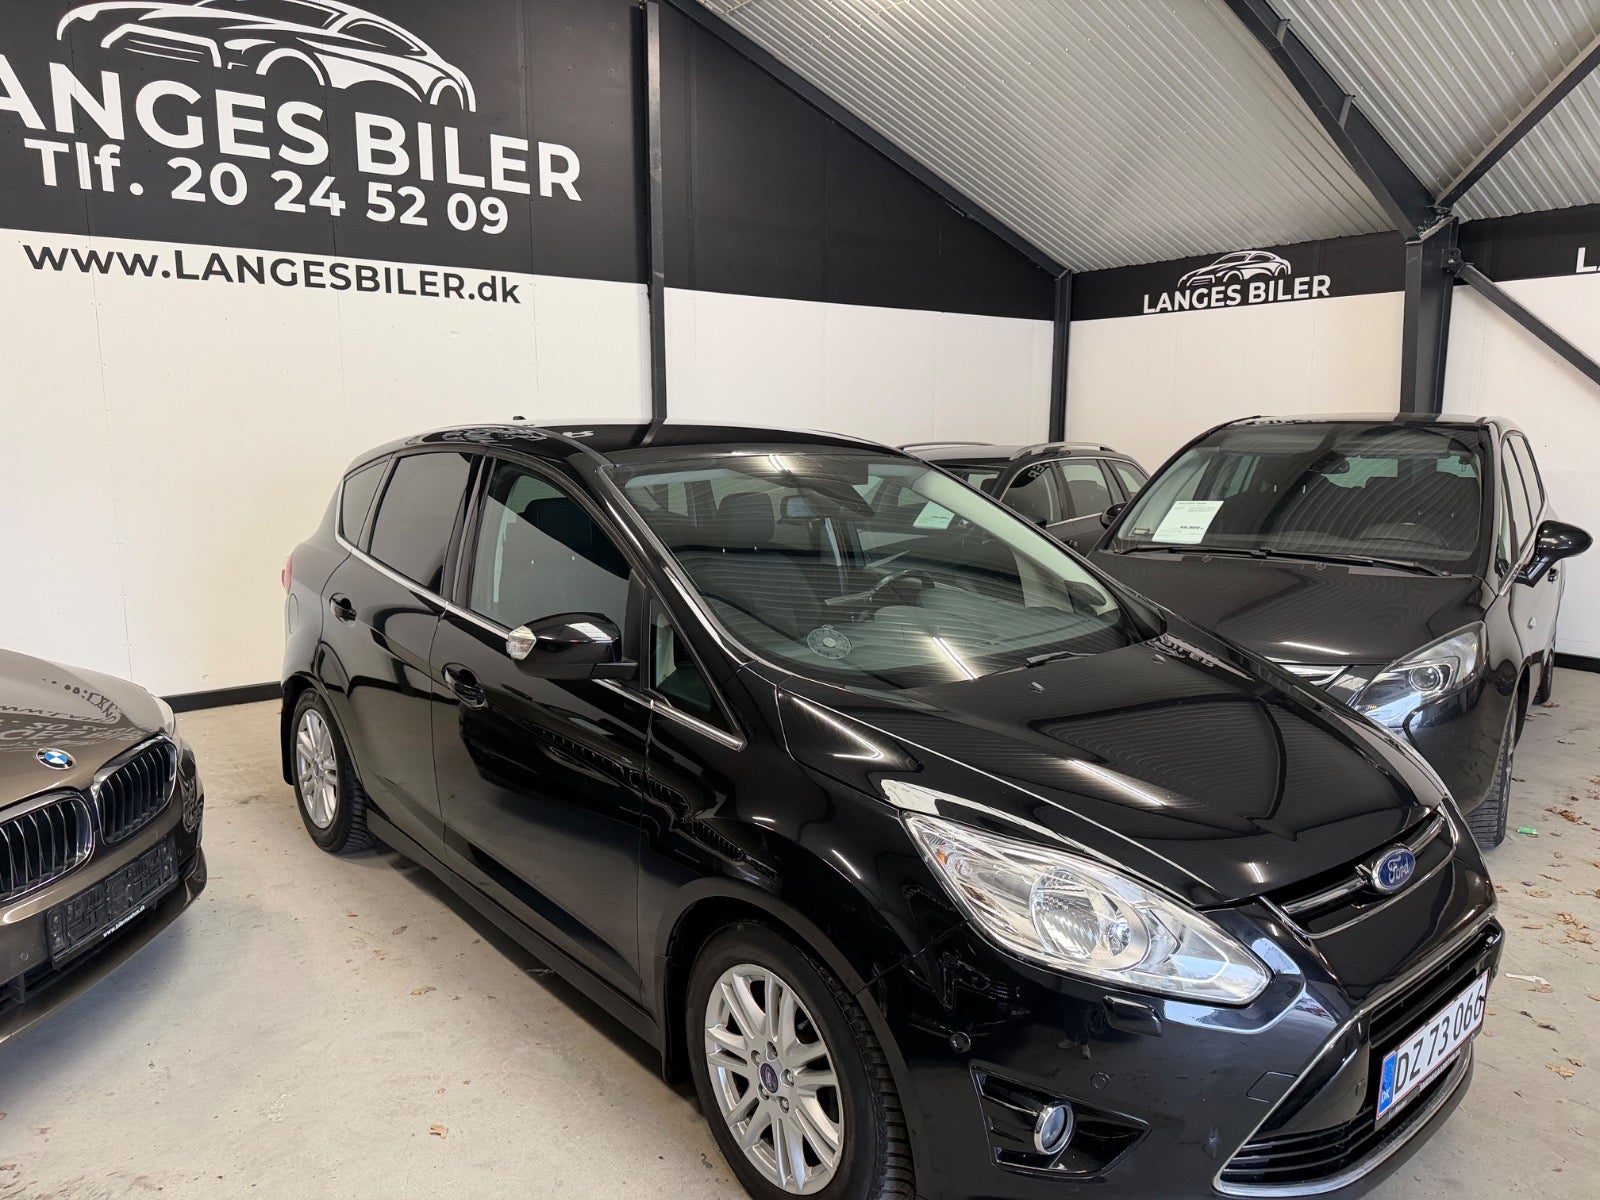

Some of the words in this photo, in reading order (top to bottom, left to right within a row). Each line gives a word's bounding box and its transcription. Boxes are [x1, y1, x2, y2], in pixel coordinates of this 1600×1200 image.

[23, 137, 145, 196] Tlf.
[167, 157, 248, 206] 20
[270, 168, 347, 217] 24
[365, 183, 429, 227] 52
[447, 196, 510, 235] 09
[355, 111, 583, 202] BILER
[22, 243, 522, 305] www.LANGESBILER.dk
[1143, 284, 1242, 314] LANGES
[1248, 274, 1332, 304] BILER
[1387, 854, 1410, 884] Ford
[1394, 1037, 1424, 1095] DZ
[1427, 1015, 1450, 1066] 73
[1453, 983, 1483, 1041] 066
